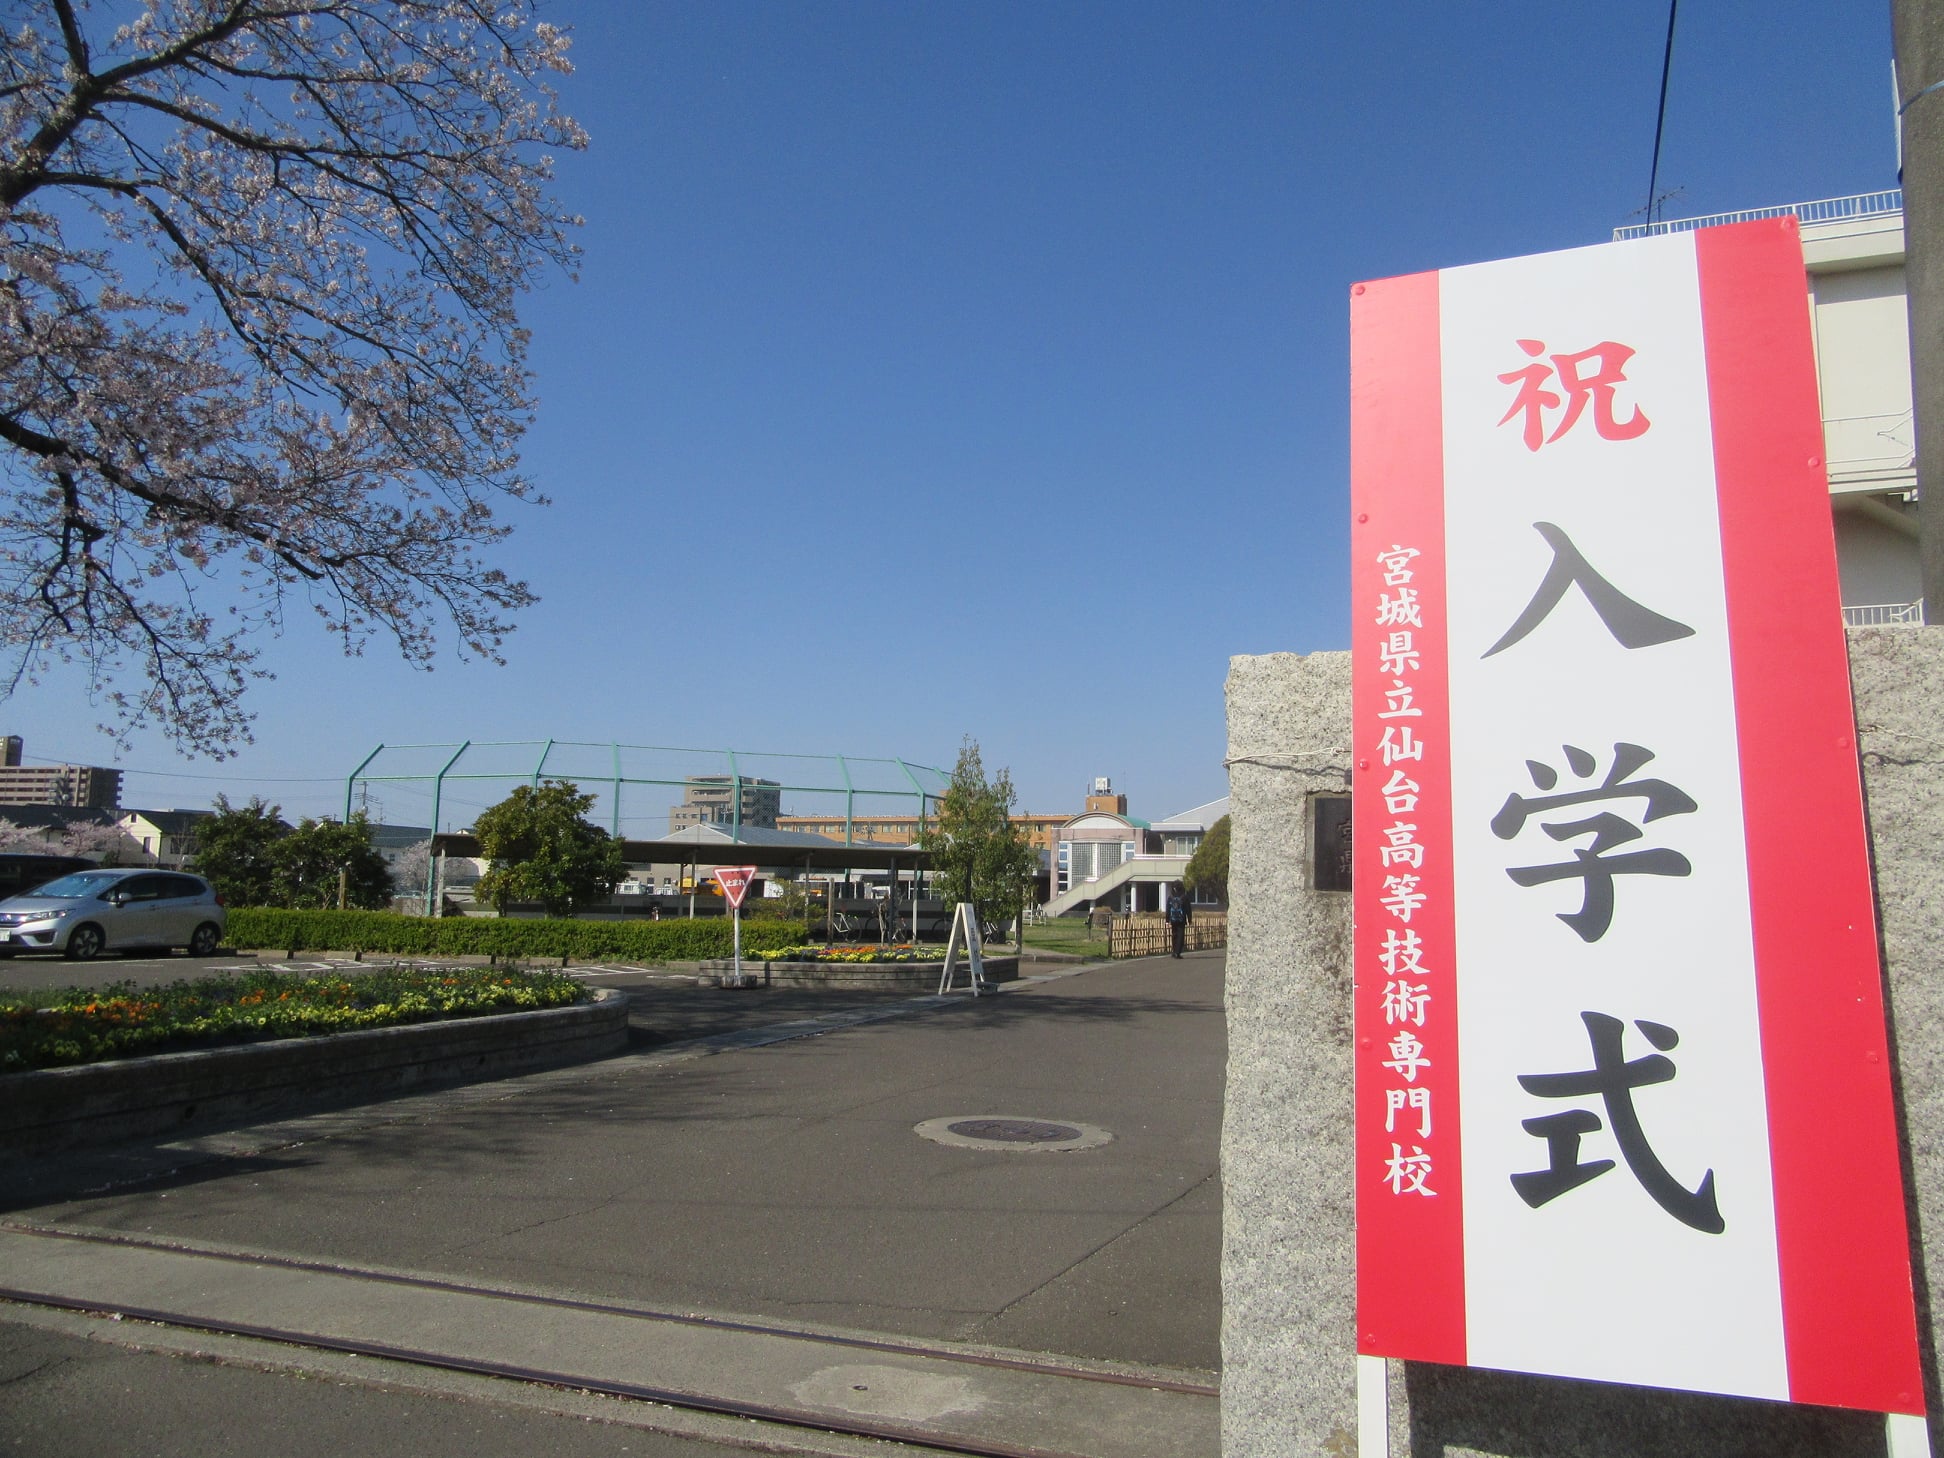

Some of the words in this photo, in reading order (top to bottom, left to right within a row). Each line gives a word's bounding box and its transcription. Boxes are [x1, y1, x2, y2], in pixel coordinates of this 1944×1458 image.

[1496, 339, 1651, 452] 祝
[726, 879, 745, 887] 止まれ
[1375, 543, 1438, 1197] 宮城県立仙台高等技術専門校
[1481, 521, 1725, 1235] 入学式
